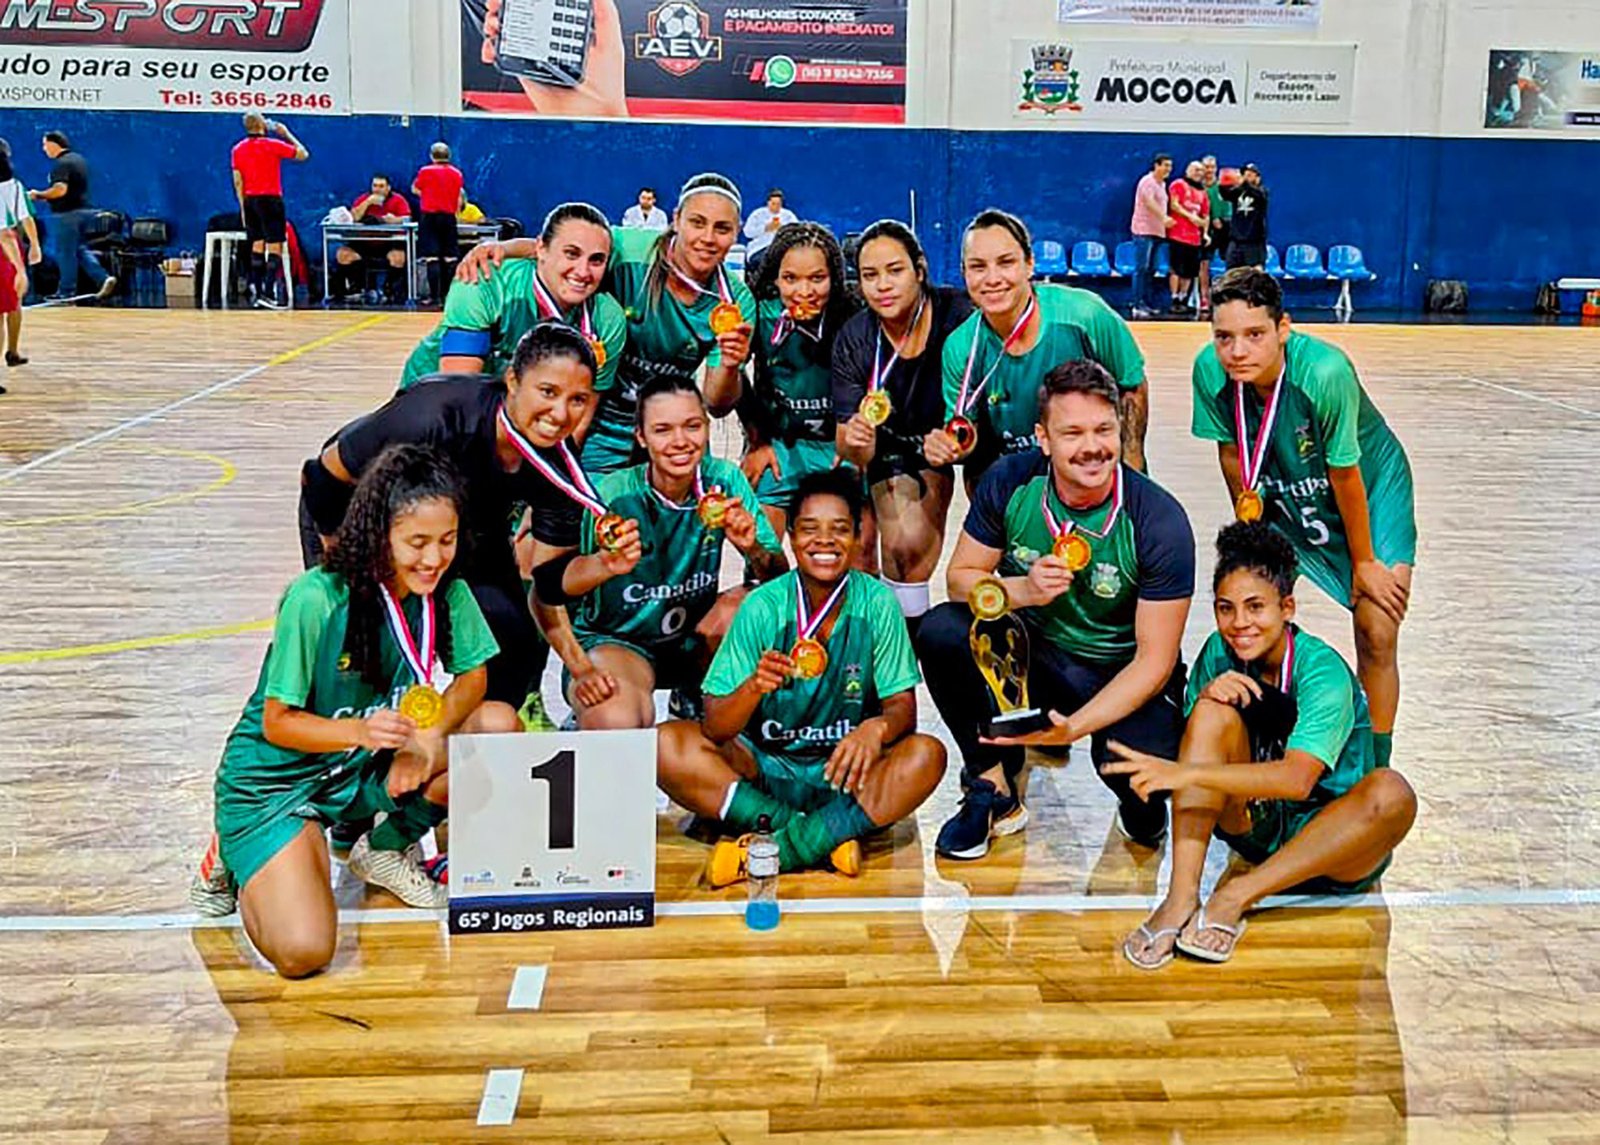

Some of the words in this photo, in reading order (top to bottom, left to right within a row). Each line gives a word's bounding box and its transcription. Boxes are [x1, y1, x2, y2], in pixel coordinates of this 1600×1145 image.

[735, 21, 823, 34] PAGAMENTO
[643, 38, 714, 57] AEV
[60, 58, 132, 81] para
[142, 60, 198, 79] seu
[210, 61, 330, 84] esporte
[1109, 59, 1164, 73] Prefeitura
[1168, 60, 1226, 74] Municipal
[159, 89, 202, 106] Tel:
[210, 91, 332, 109] 3656-2846
[1095, 77, 1237, 104] MOCOCA
[531, 750, 576, 849] 1
[492, 911, 546, 931] Jogos
[552, 905, 645, 929] Regionais
